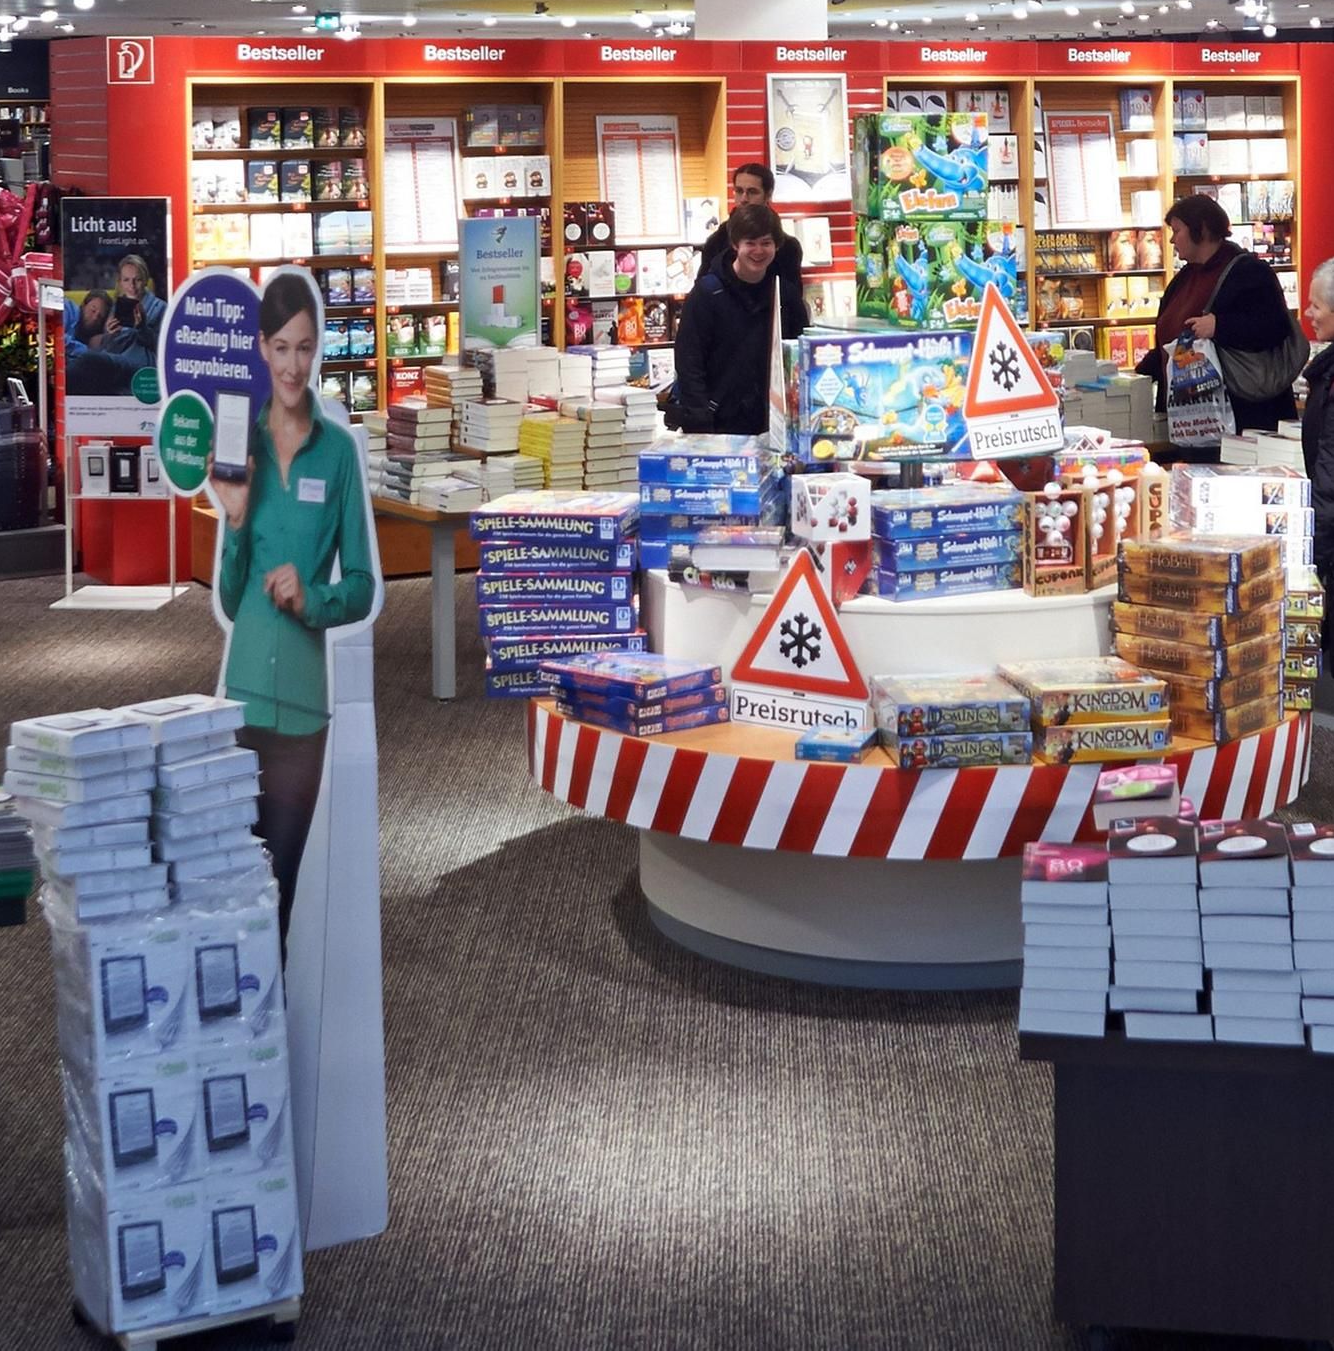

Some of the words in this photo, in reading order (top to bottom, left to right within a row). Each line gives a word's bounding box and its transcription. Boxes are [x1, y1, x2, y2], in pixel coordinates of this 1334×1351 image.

[238, 45, 324, 61] Bestseller
[424, 45, 505, 61] Bestseller
[601, 46, 676, 62] Bestseller
[776, 46, 846, 62] Bestseller
[921, 47, 987, 63] Bestseller
[1068, 48, 1131, 63] Bestseller
[1201, 48, 1261, 63] Bestseller
[71, 217, 105, 233] Licht
[108, 216, 138, 233] aus!
[476, 248, 524, 260] Bestseller
[185, 296, 214, 318] Mein
[216, 298, 245, 324] Tipp:
[175, 325, 228, 352] eReading
[230, 329, 254, 350] hier
[175, 357, 253, 380] ausprobieren.
[974, 419, 1058, 451] Preisrutsch
[477, 516, 594, 534] SPIELE-SAMMLUNG
[487, 546, 609, 564] SPIELE-SAMMLUNG
[482, 578, 605, 595] SPIELE-SAMMLUNG
[486, 609, 610, 627] SPIELE-SAMMLUNG
[1073, 690, 1147, 715] KINGDOM
[736, 695, 858, 730] Preisrutsch
[930, 707, 1000, 724] DOMINION
[1076, 727, 1152, 750] KINGDOM
[931, 741, 1002, 758] DOMINION
